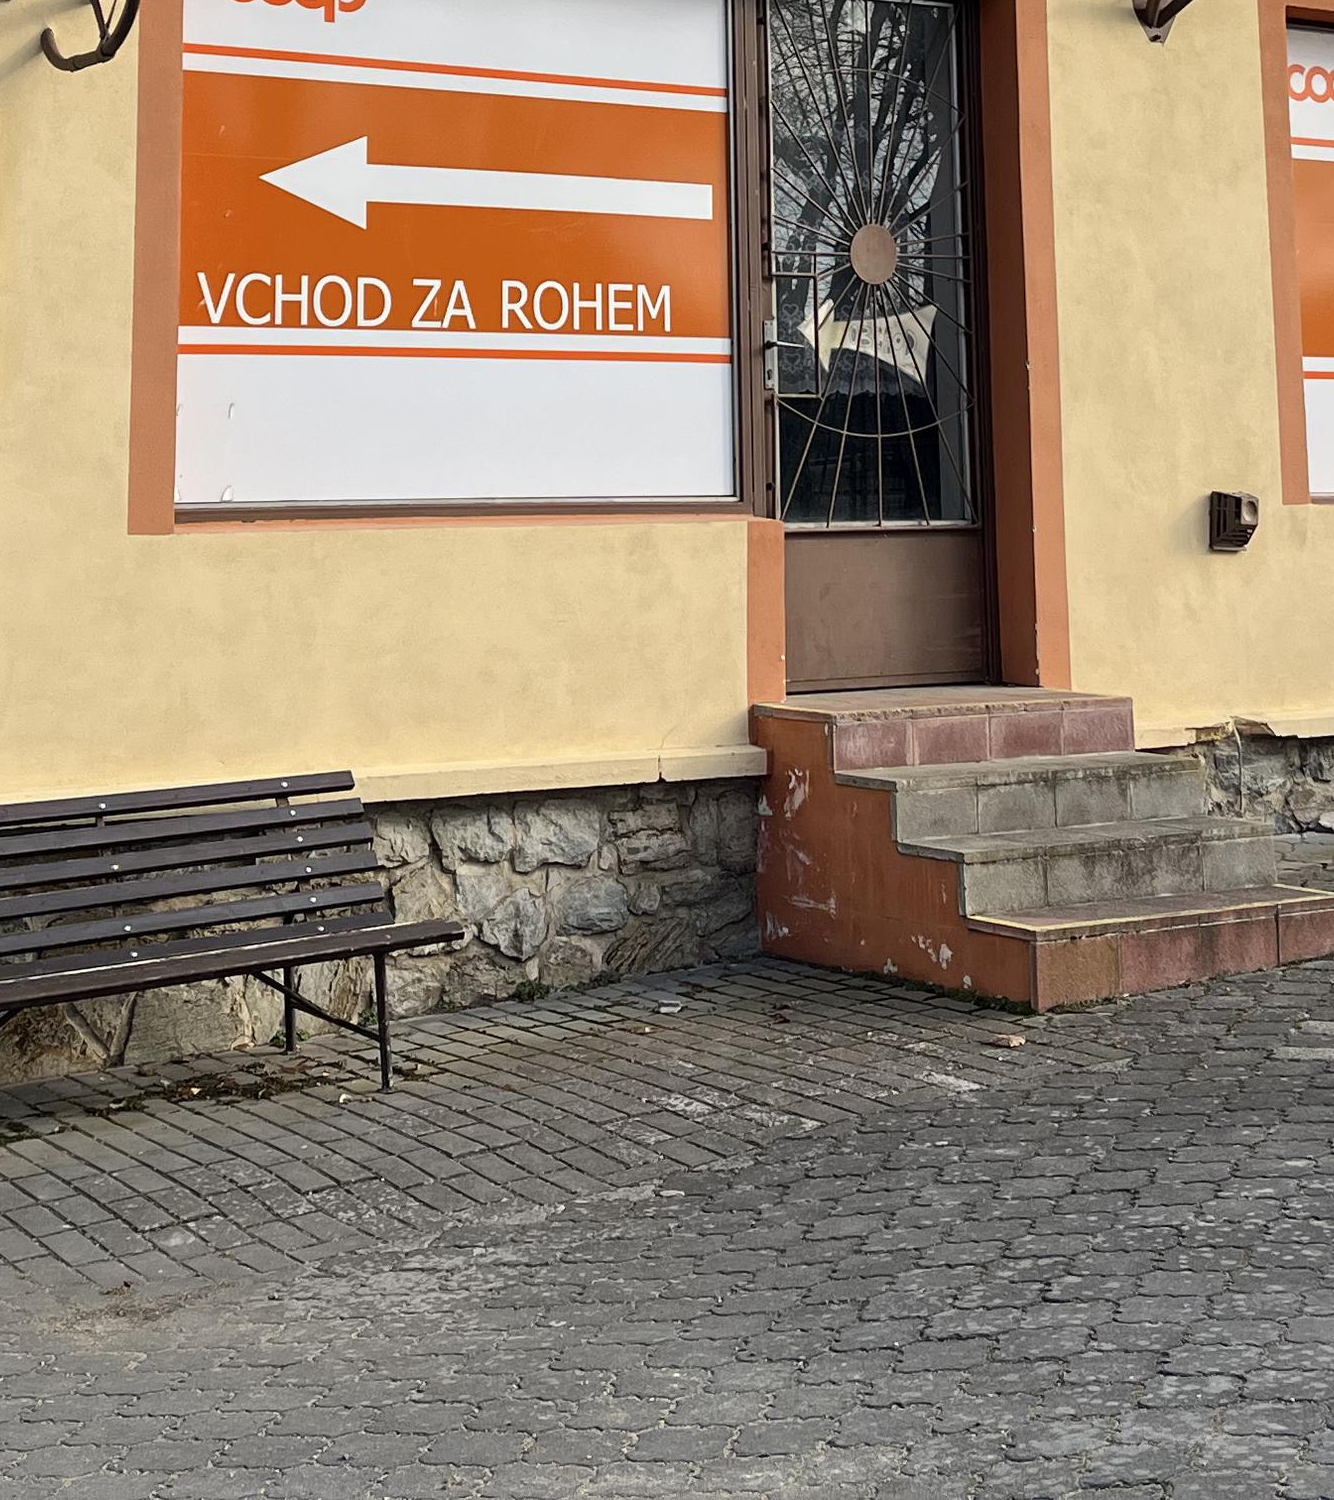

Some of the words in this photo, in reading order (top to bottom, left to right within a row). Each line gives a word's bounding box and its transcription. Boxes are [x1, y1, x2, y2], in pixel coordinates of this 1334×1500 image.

[196, 272, 392, 327] VCHOD
[410, 278, 477, 329] ZA
[500, 280, 672, 332] ROHEM
